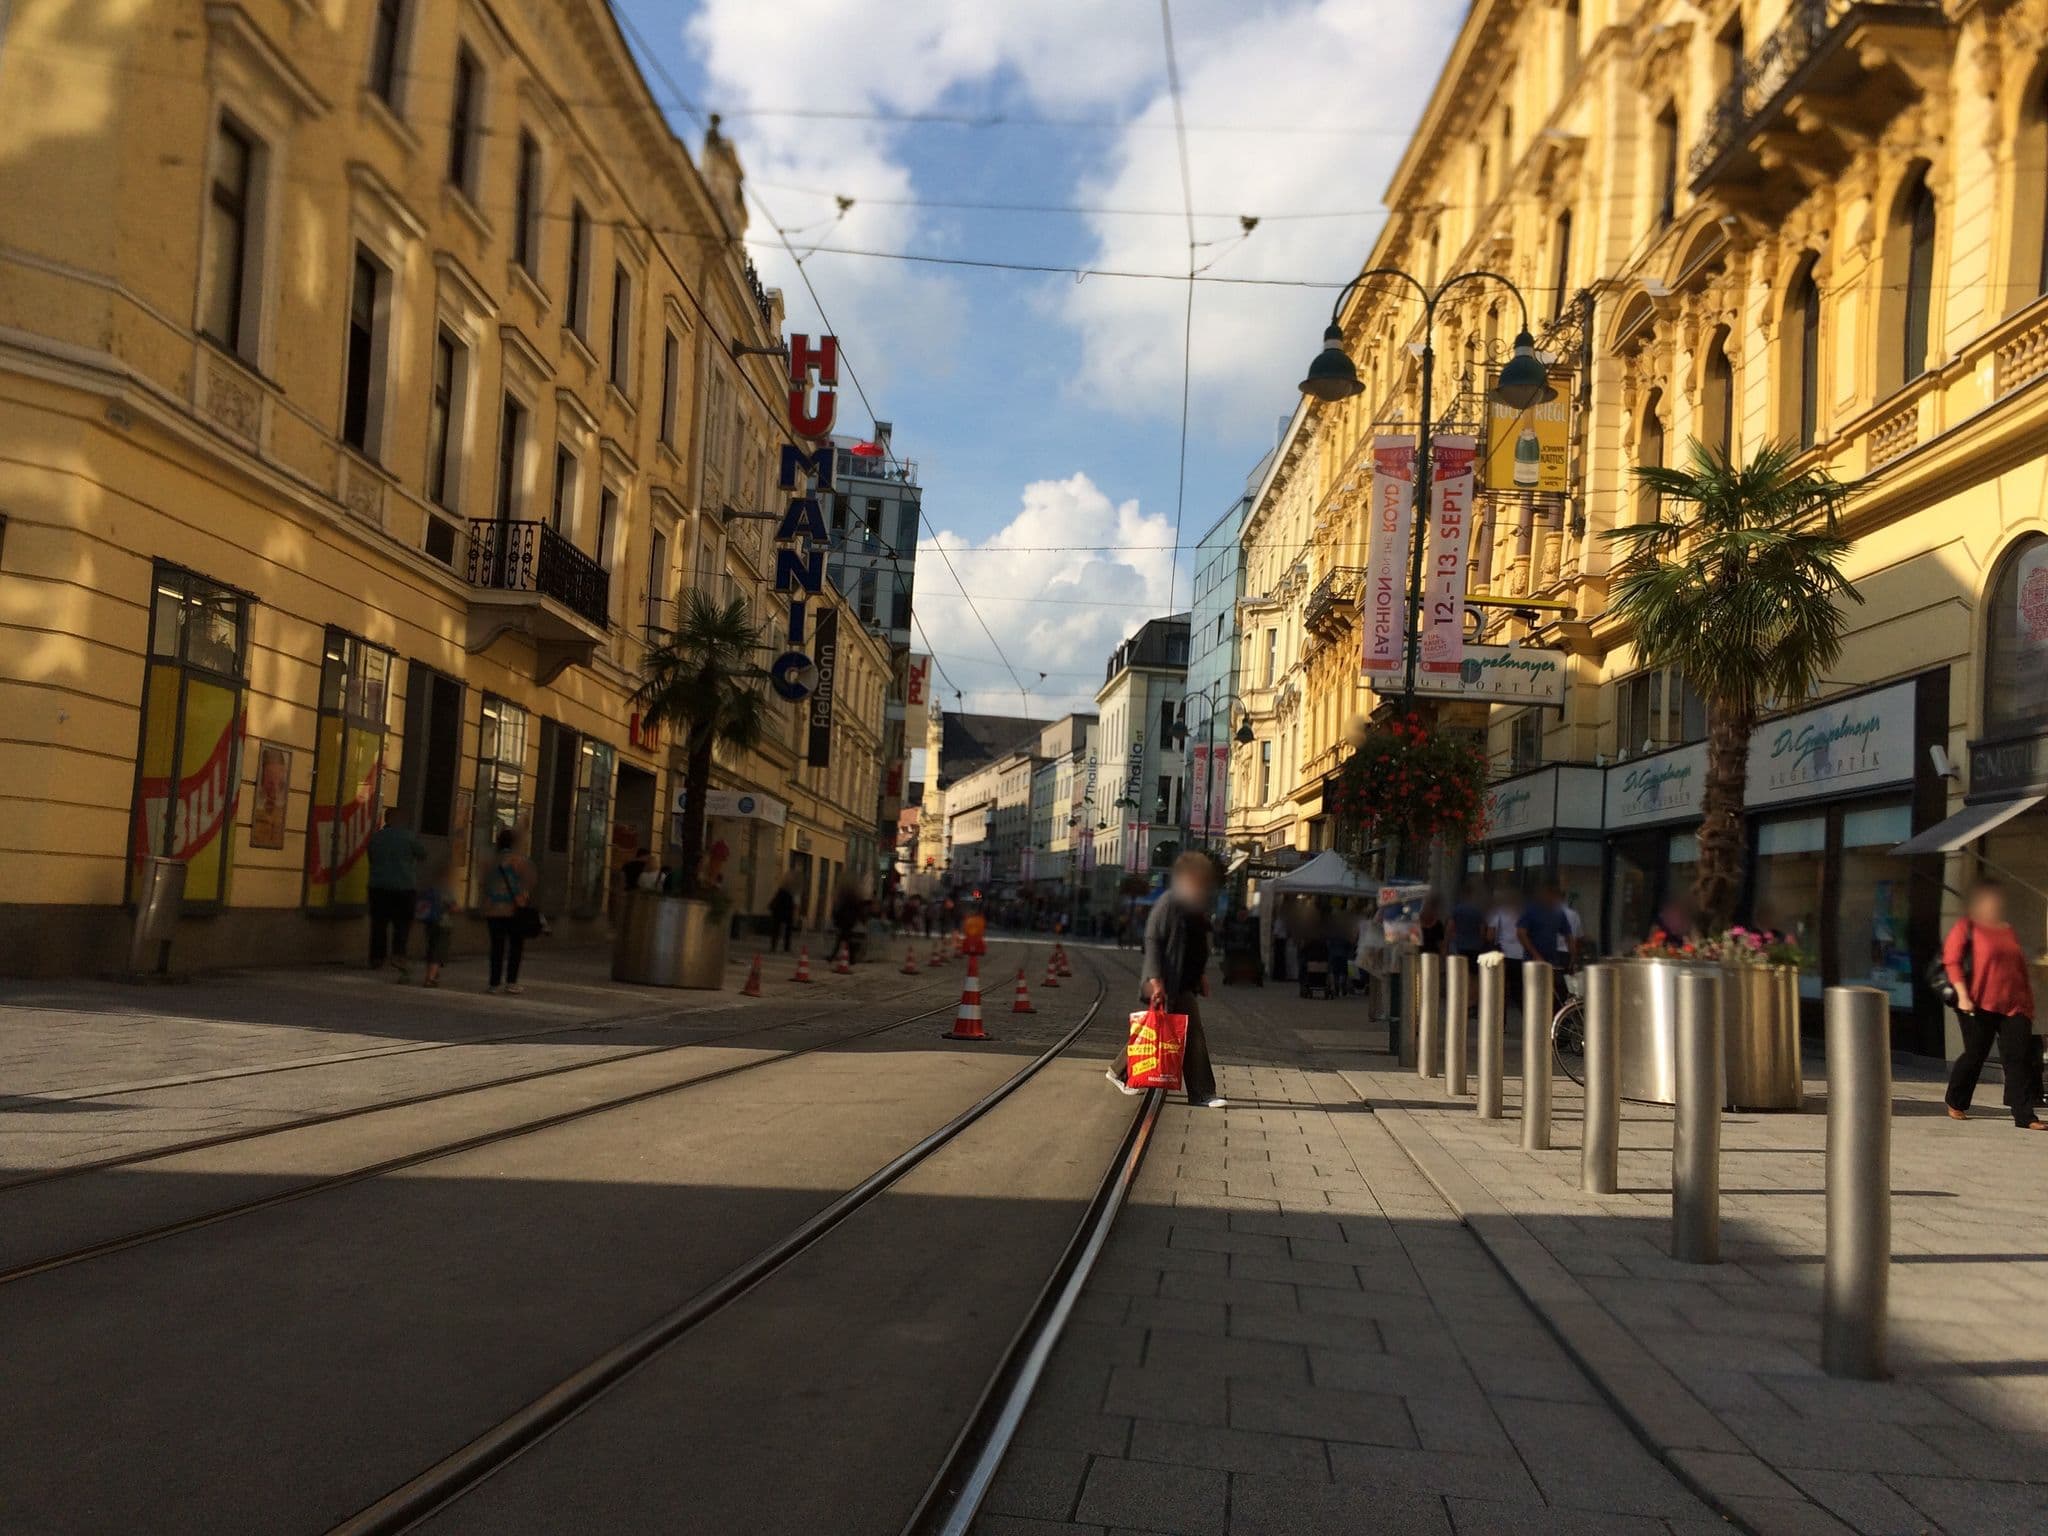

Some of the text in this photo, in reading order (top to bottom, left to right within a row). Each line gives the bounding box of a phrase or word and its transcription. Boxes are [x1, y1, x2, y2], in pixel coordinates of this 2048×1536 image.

[772, 334, 839, 700] HUMANIC
[1440, 482, 1464, 540] SEPT.
[1127, 743, 1143, 796] Thalia
